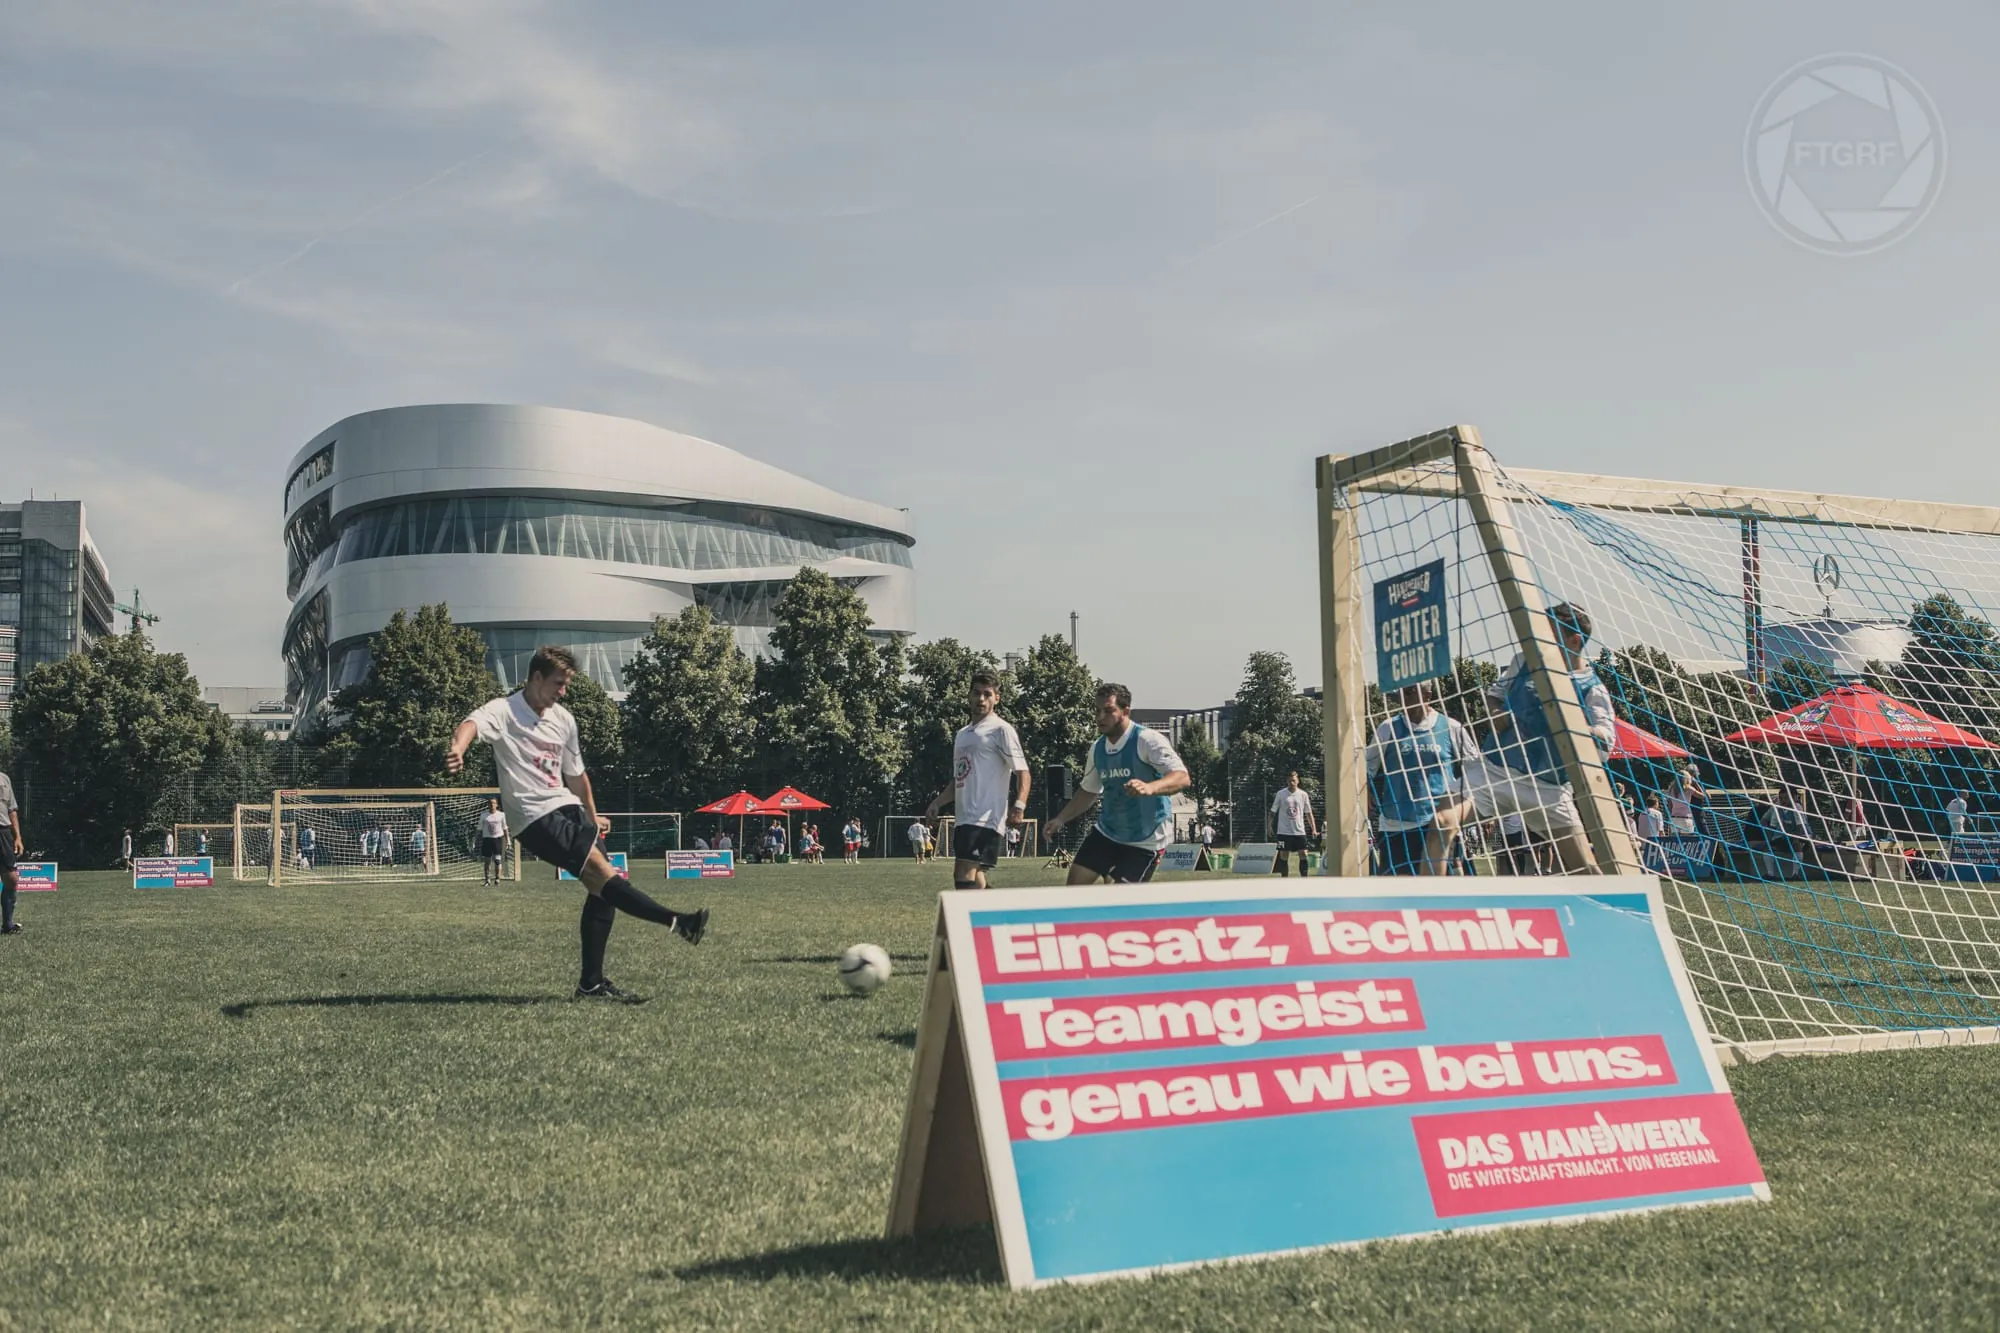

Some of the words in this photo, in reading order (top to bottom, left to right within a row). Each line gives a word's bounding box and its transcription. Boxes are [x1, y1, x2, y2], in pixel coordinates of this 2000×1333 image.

[1382, 605, 1441, 653] CENTER
[1391, 643, 1434, 682] COURT
[1109, 768, 1131, 778] JAKO
[989, 918, 1289, 974] Einsatz,
[1290, 908, 1558, 956] Technik,
[1003, 981, 1408, 1049] Teamgeist:
[1020, 1072, 1263, 1141] genau
[1273, 1050, 1411, 1104] wie
[1417, 1041, 1524, 1092] bei
[1532, 1046, 1662, 1085] uns.
[1438, 1134, 1514, 1169] DAS
[1519, 1113, 1711, 1162] HANDWERK
[1448, 1171, 1474, 1190] DIE
[1476, 1158, 1623, 1186] WIRTSCHAFTSMACHT.
[1625, 1154, 1652, 1174] VON
[1654, 1148, 1720, 1169] NEBENAN.
